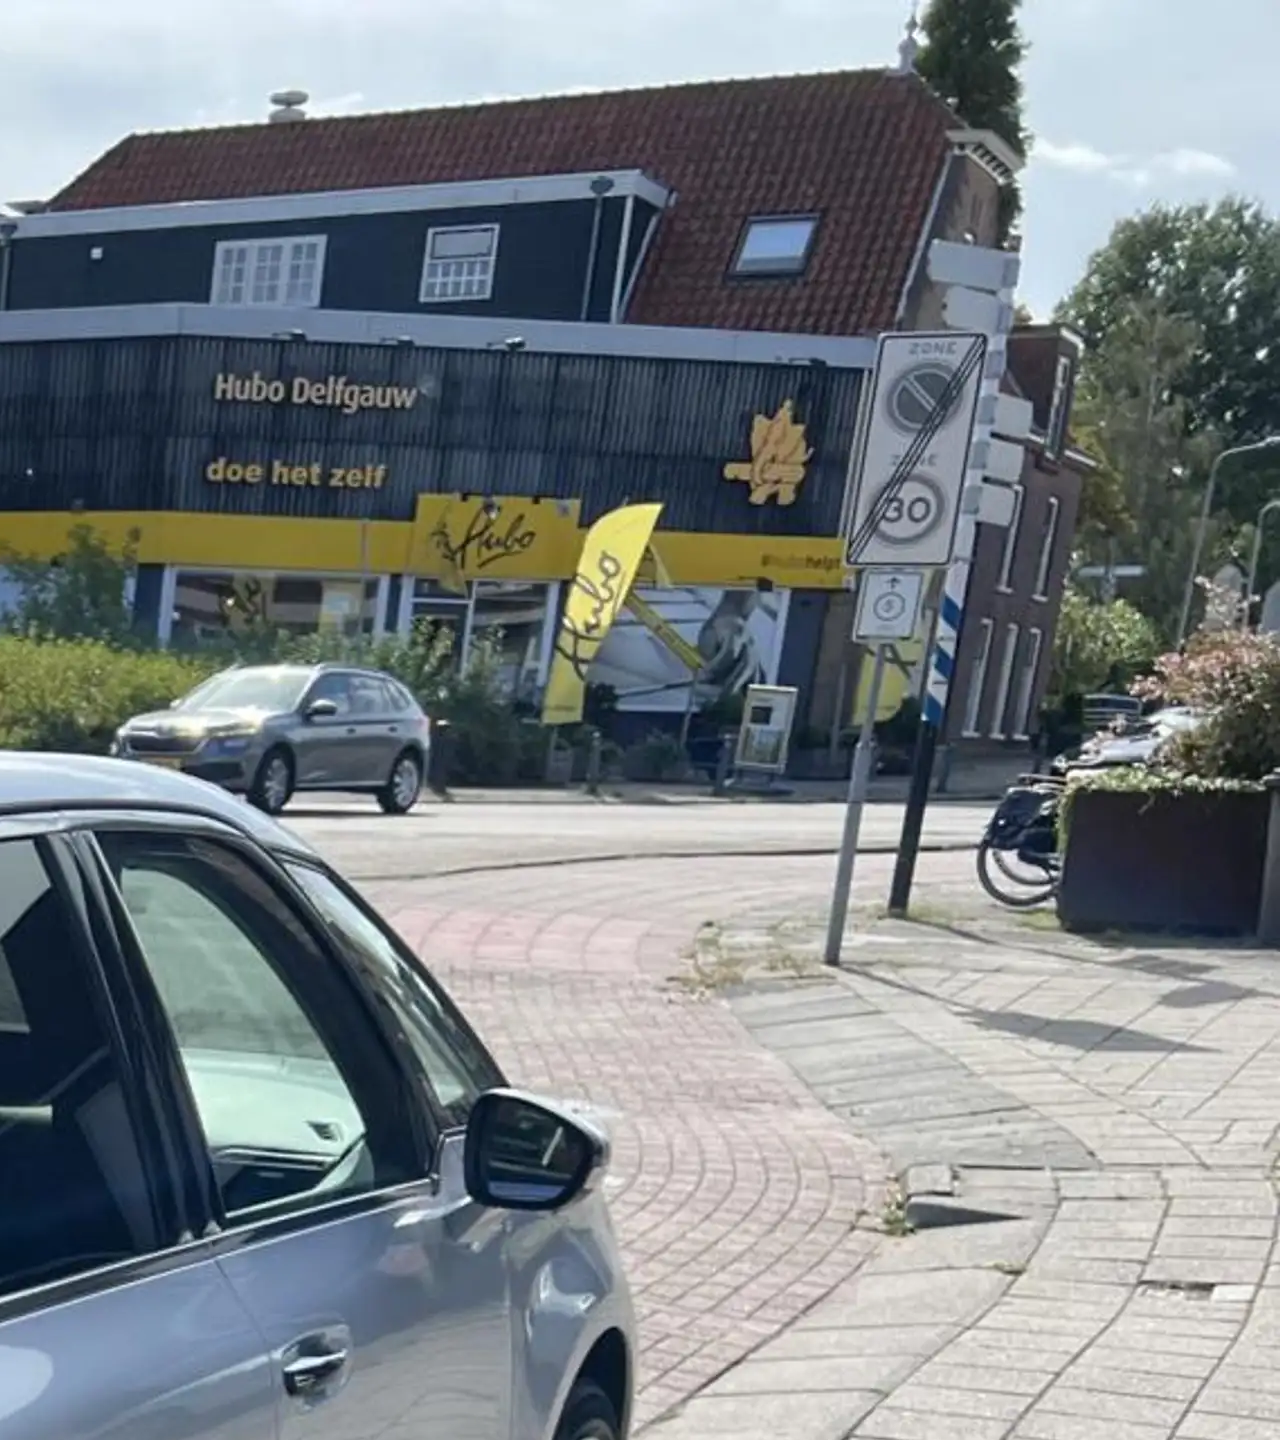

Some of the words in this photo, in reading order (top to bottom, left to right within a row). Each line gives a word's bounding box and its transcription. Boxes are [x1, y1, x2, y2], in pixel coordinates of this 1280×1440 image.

[908, 341, 958, 356] ZONE
[214, 370, 285, 402] Hubo
[291, 374, 418, 415] Delfgauw
[206, 457, 263, 484] doe
[271, 460, 322, 487] het
[328, 464, 388, 489] zelf
[890, 453, 939, 467] ZNE
[881, 496, 932, 522] 30
[445, 501, 537, 570] Hubo
